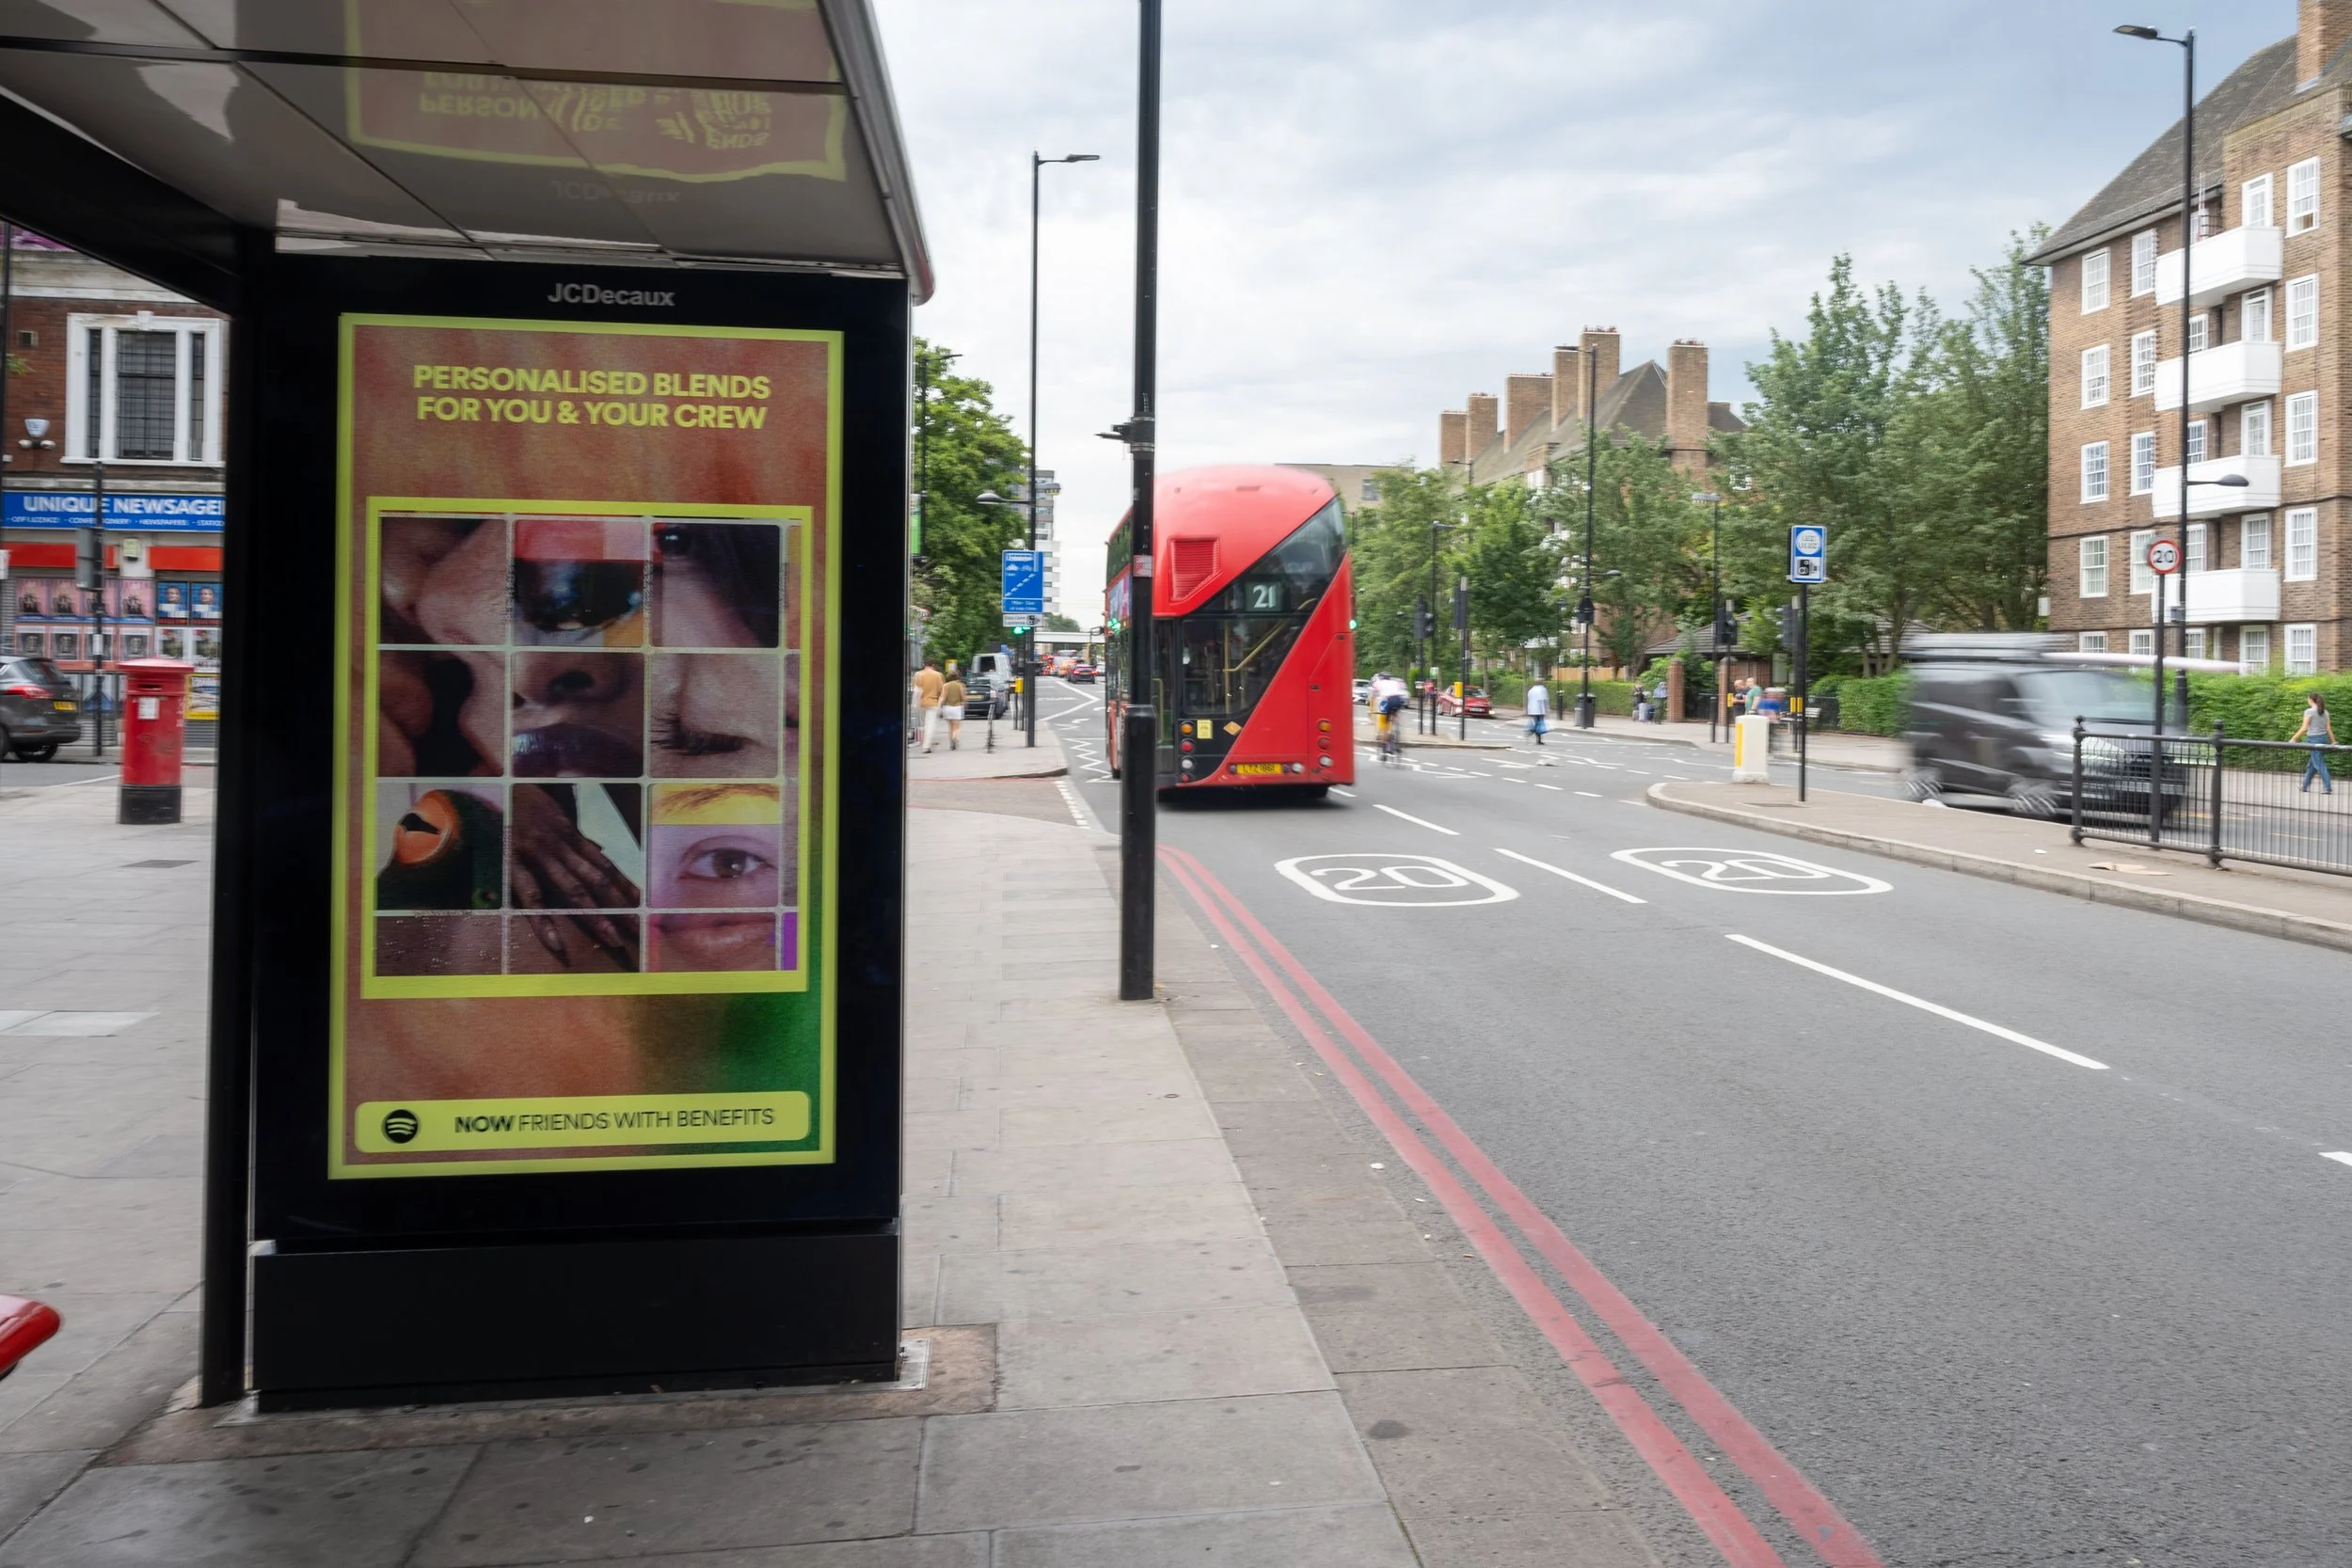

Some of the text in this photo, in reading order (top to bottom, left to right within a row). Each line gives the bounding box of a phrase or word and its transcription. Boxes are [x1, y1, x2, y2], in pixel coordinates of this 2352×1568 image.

[547, 282, 675, 307] JCDecaux
[413, 365, 771, 400] PERSONALISED BLENDS
[417, 396, 768, 430] FOR YOU & YOUR CREW
[24, 496, 111, 513] UNIQUE
[2153, 549, 2175, 563] 20
[1252, 584, 1277, 609] 21
[1309, 865, 1470, 891] 20
[1660, 854, 1832, 881] 20
[454, 1107, 775, 1133] NOW FRIENDS WITH BENEFITS
